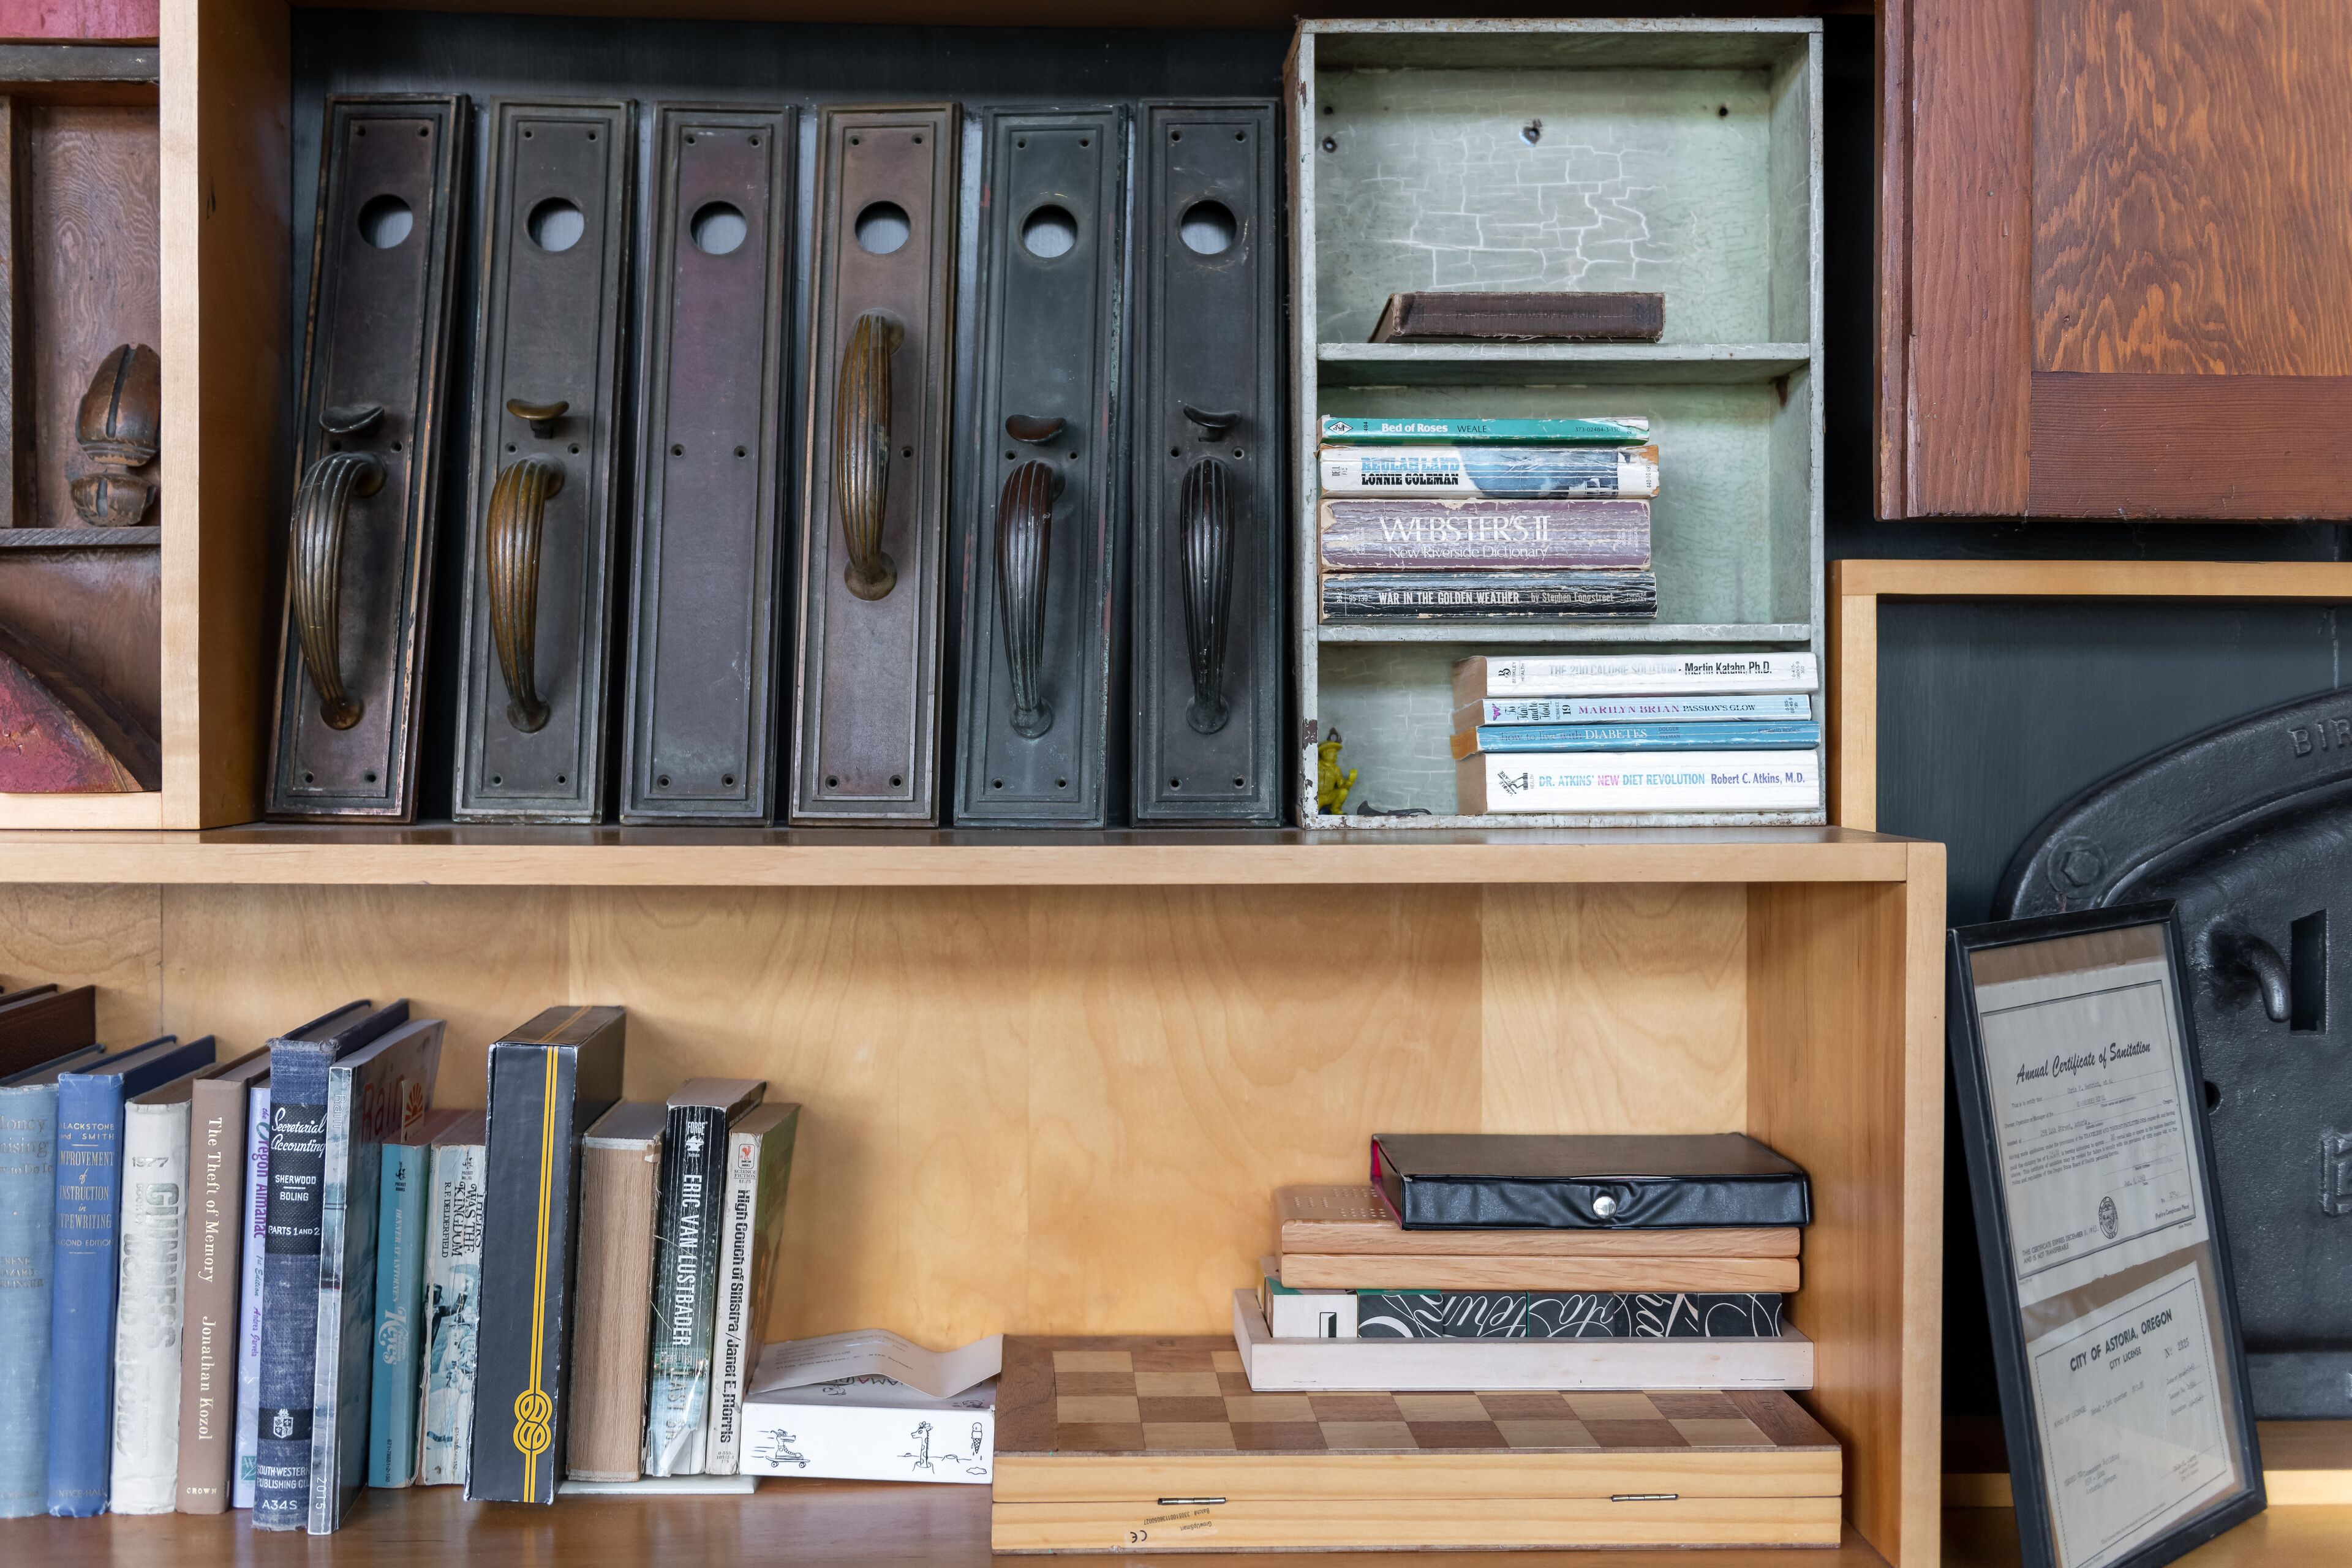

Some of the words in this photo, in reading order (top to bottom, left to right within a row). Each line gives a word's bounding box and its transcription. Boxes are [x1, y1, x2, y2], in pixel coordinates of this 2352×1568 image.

[1382, 423, 1403, 432] Bed
[1404, 423, 1412, 432] of
[1414, 423, 1448, 432] Roses
[1361, 458, 1421, 472] BEULAH
[1422, 458, 1460, 472] LAND
[1362, 473, 1403, 485] LONNIE
[1405, 473, 1459, 485] COLEMAN
[1379, 515, 1529, 542] WEBSTER'S
[1532, 515, 1551, 542] II
[1389, 546, 1419, 558] New
[1423, 545, 1479, 559] Riverside
[1483, 545, 1548, 560] Dictionary
[1379, 592, 1400, 605] WAR
[1403, 592, 1413, 605] IN
[1416, 592, 1434, 605] THE
[1438, 592, 1473, 605] GOLDEN
[1531, 592, 1539, 603] by
[1542, 592, 1572, 603] Stephen
[1574, 592, 1615, 603] Longstreet
[1684, 663, 1714, 675] Martin
[1749, 661, 1772, 674] Ph.D.
[1505, 706, 1517, 715] To
[1562, 704, 1572, 715] 19
[1578, 706, 1636, 714] MARILYN
[1640, 705, 1679, 714] BRIAN
[1501, 733, 1523, 741] how
[1526, 733, 1536, 741] to
[1559, 730, 1582, 741] with
[1585, 728, 1648, 740] DIABETES
[1539, 776, 1556, 787] DR.
[1558, 775, 1594, 786] ATKINS'
[1597, 775, 1619, 786] NEW
[1623, 774, 1643, 785] DIET
[1646, 774, 1705, 786] REVOLUTION
[1711, 773, 1741, 785] Robert
[1743, 774, 1751, 784] C.
[1752, 772, 1784, 786] Atkins,
[1785, 772, 1806, 784] M.D.
[2016, 1058, 2049, 1085] Annual
[2052, 1050, 2097, 1082] Certificate
[2098, 1047, 2109, 1070] of
[2109, 1039, 2152, 1062] Sanitation
[272, 1107, 328, 1133] Secretarial
[333, 1093, 347, 1129] Rain
[208, 1117, 223, 1146] The
[687, 1121, 706, 1135] FORGE
[252, 1121, 270, 1178] Oregon
[271, 1133, 326, 1159] Accounting
[132, 1156, 169, 1167] 1977
[206, 1152, 222, 1194] Theft
[79, 1168, 89, 1183] of
[275, 1174, 317, 1185] SHERWOOD
[59, 1185, 109, 1201] INSTRUCTION
[280, 1191, 309, 1201] BOLING
[464, 1183, 478, 1219] WAS
[682, 1174, 703, 1208] ERIC
[78, 1203, 86, 1212] in
[206, 1200, 219, 1217] of
[253, 1183, 268, 1238] Almanac
[735, 1189, 751, 1221] High
[268, 1226, 292, 1235] PARTS
[293, 1226, 298, 1235] 1
[314, 1227, 320, 1235] 2
[442, 1199, 451, 1258] DELDERFIELD
[451, 1181, 466, 1257] KINGDOM
[679, 1215, 700, 1248] VAN
[464, 1222, 475, 1254] THE
[733, 1223, 748, 1265] Couch
[198, 1220, 219, 1284] Memory
[254, 1268, 264, 1297] Edition
[731, 1267, 744, 1282] of
[673, 1255, 697, 1346] LUSTBADER
[728, 1282, 744, 1332] Silistra
[253, 1306, 262, 1332] Andrea
[379, 1306, 409, 1365] Keyes
[2069, 1351, 2088, 1373] CITY
[2090, 1343, 2102, 1362] OF
[2104, 1325, 2138, 1355] ASTORIA,
[2140, 1308, 2173, 1336] OREGON
[2176, 1336, 2190, 1352] 2325
[200, 1316, 216, 1393] Jonathan
[725, 1340, 739, 1378] Janet
[2109, 1356, 2121, 1370] CITY
[2122, 1345, 2142, 1363] LICENSE
[198, 1397, 215, 1441] Kozol
[720, 1393, 736, 1444] Morris
[257, 1477, 296, 1489] PUBLISHING
[315, 1477, 328, 1510] 2015
[262, 1499, 298, 1510] A34S
[1180, 1521, 1212, 1531] GrowUpSmart
